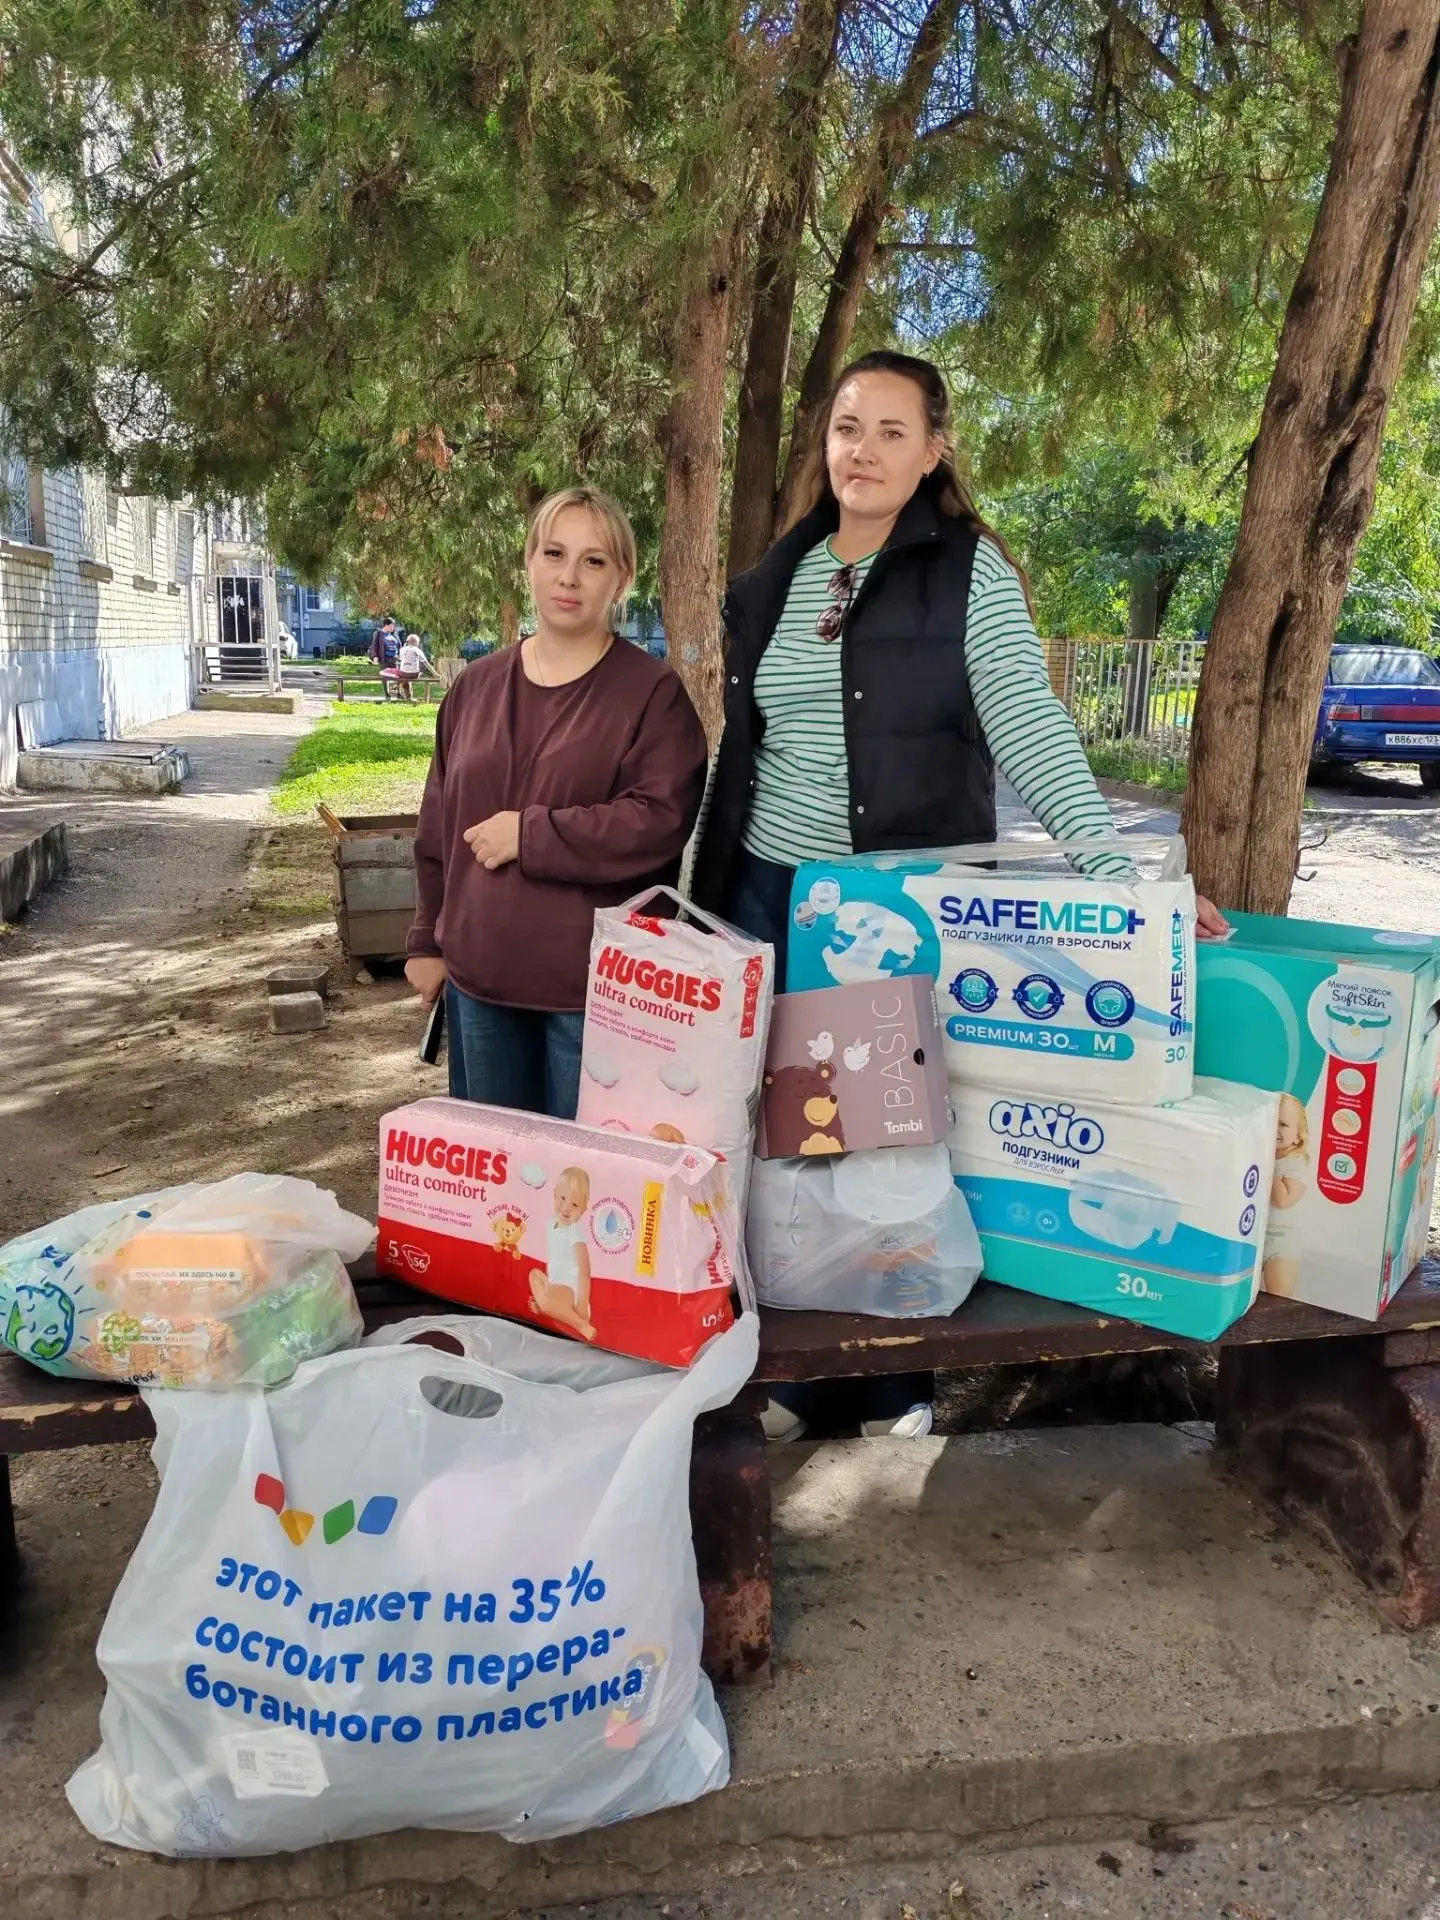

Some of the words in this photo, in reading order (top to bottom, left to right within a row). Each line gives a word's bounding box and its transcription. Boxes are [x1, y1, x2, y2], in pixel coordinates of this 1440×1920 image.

[940, 895, 1145, 935] SAFEMED+
[942, 929, 1023, 944] ПОДГУЗНИКИ
[1026, 935, 1053, 946] ДЛЯ
[1058, 937, 1132, 950] ВЗРОСЛЫХ
[597, 946, 722, 1012] HUGGIES
[1328, 980, 1358, 992] Мягкий
[1361, 986, 1392, 996] поясок
[594, 980, 626, 1004] ultra
[630, 996, 696, 1027] comfort
[872, 997, 914, 1108] BASIC
[954, 1023, 1034, 1045] PREMIUM
[1038, 1032, 1070, 1050] 30
[1094, 1033, 1116, 1052] M
[1165, 1046, 1185, 1064] 30
[989, 1100, 1104, 1154] axio
[386, 1129, 508, 1185] HUGGIES
[1003, 1142, 1080, 1169] ПОДГУЗНИКИ
[386, 1166, 419, 1187] ultra
[424, 1178, 487, 1202] comfort
[388, 1240, 399, 1258] 5
[642, 1200, 656, 1264] НОВИНКА
[1116, 1272, 1148, 1298] 30
[216, 1558, 302, 1607] этот
[308, 1591, 432, 1628] пакет
[444, 1592, 496, 1623] на
[509, 1560, 606, 1624] 35%
[196, 1616, 364, 1684] состоит
[378, 1652, 432, 1684] из
[447, 1627, 626, 1692] перера-
[186, 1664, 422, 1743] ботанного
[438, 1668, 642, 1742] пластика
